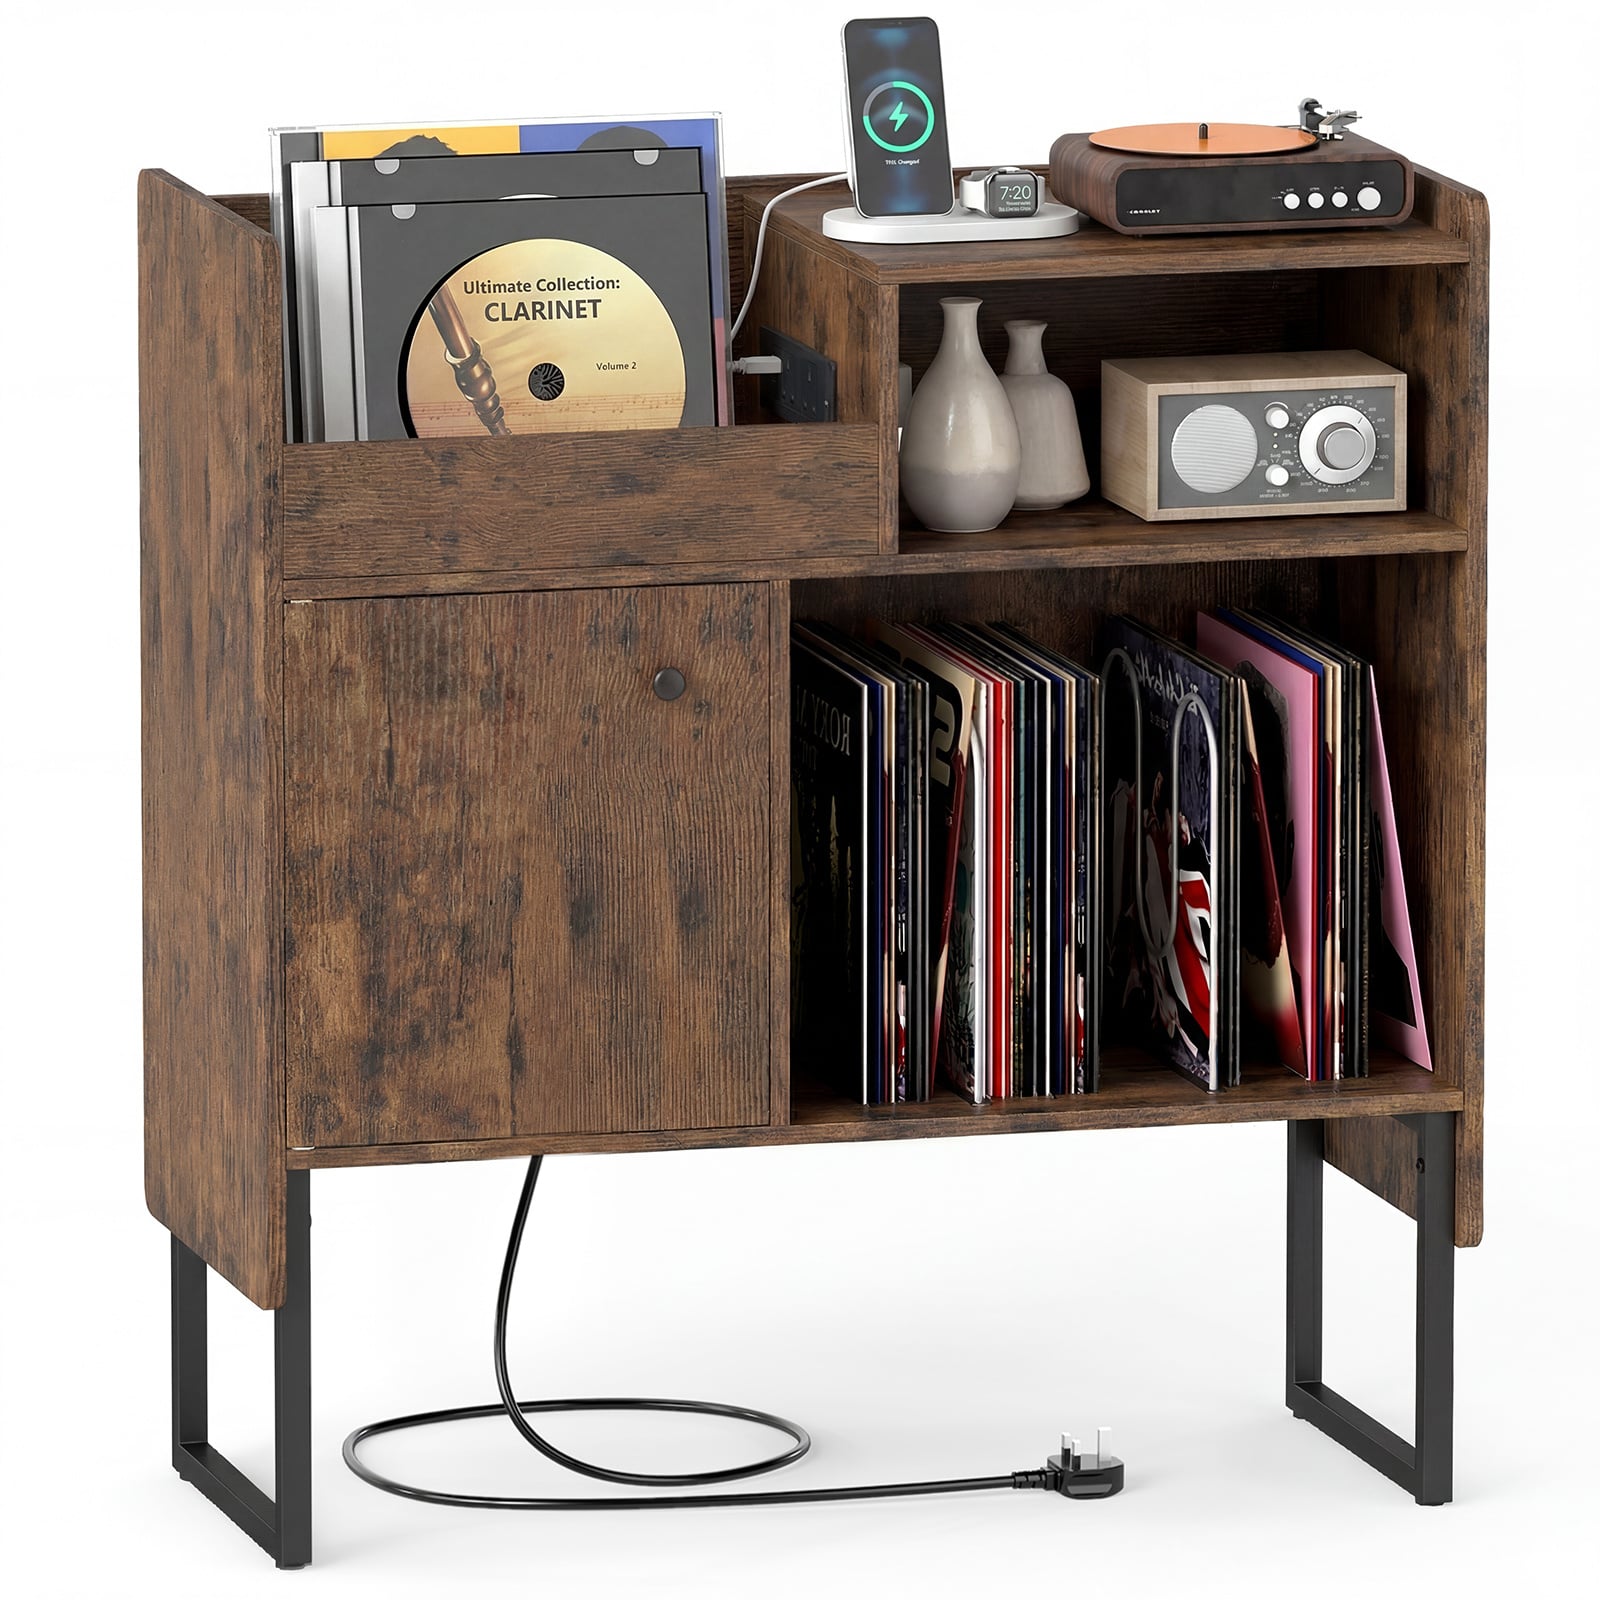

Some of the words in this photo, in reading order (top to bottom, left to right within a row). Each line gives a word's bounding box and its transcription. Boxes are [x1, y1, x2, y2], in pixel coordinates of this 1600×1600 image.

[1000, 185, 1032, 200] 7:20
[463, 280, 532, 295] Ultimate
[536, 276, 621, 292] Collection:
[484, 298, 602, 322] CLARINET
[596, 362, 629, 371] Volume
[631, 361, 637, 370] 2
